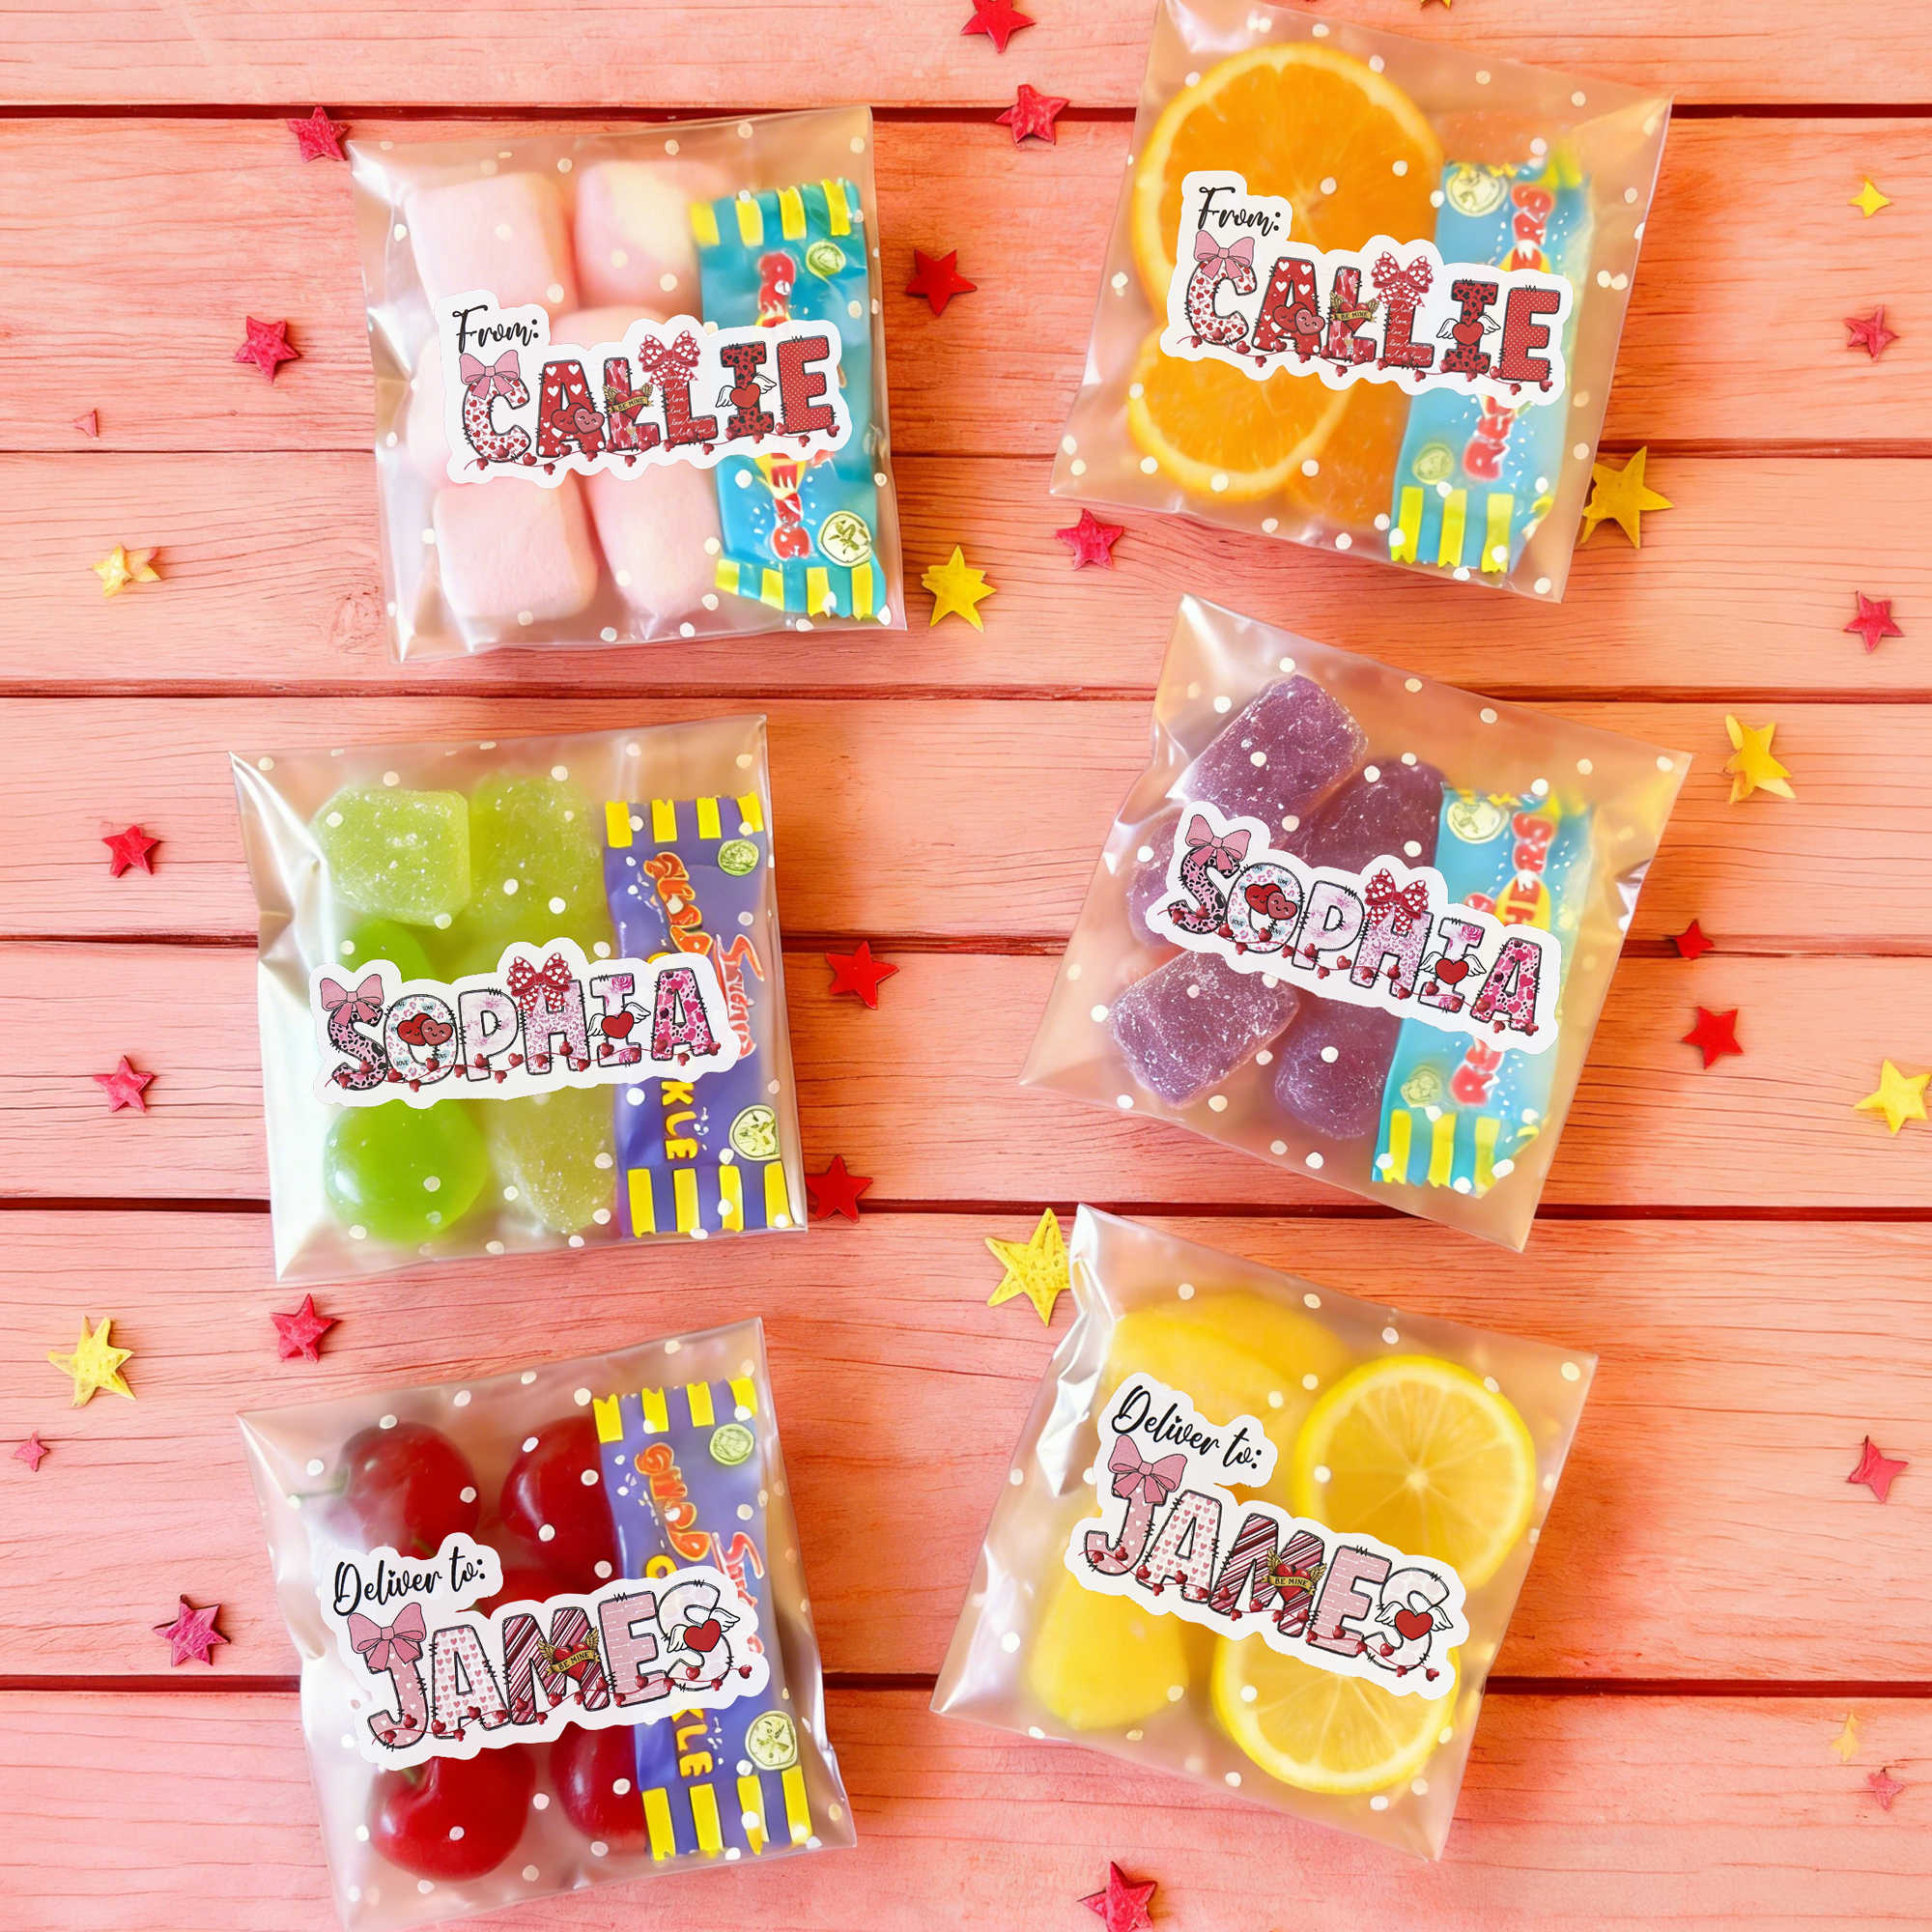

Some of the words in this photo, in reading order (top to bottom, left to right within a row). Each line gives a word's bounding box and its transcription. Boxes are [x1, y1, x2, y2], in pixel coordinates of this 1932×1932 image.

[1198, 186, 1281, 236] From:
[451, 304, 539, 354] From:
[1185, 255, 1560, 382] CALLIE
[461, 334, 834, 463] CALLIE
[629, 397, 644, 406] MINE
[1167, 846, 1543, 1034] SOPHIA
[327, 968, 714, 1092] SOPHIA
[1111, 1384, 1221, 1454] Deliver
[1223, 1426, 1265, 1471] to:
[333, 1560, 443, 1618] Deliver
[449, 1546, 487, 1596] to:
[1084, 1476, 1450, 1671] JAMES
[1289, 1577, 1308, 1586] MINE
[367, 1579, 731, 1749] JAMES
[557, 1661, 570, 1670] BE
[571, 1651, 589, 1663] MINE
